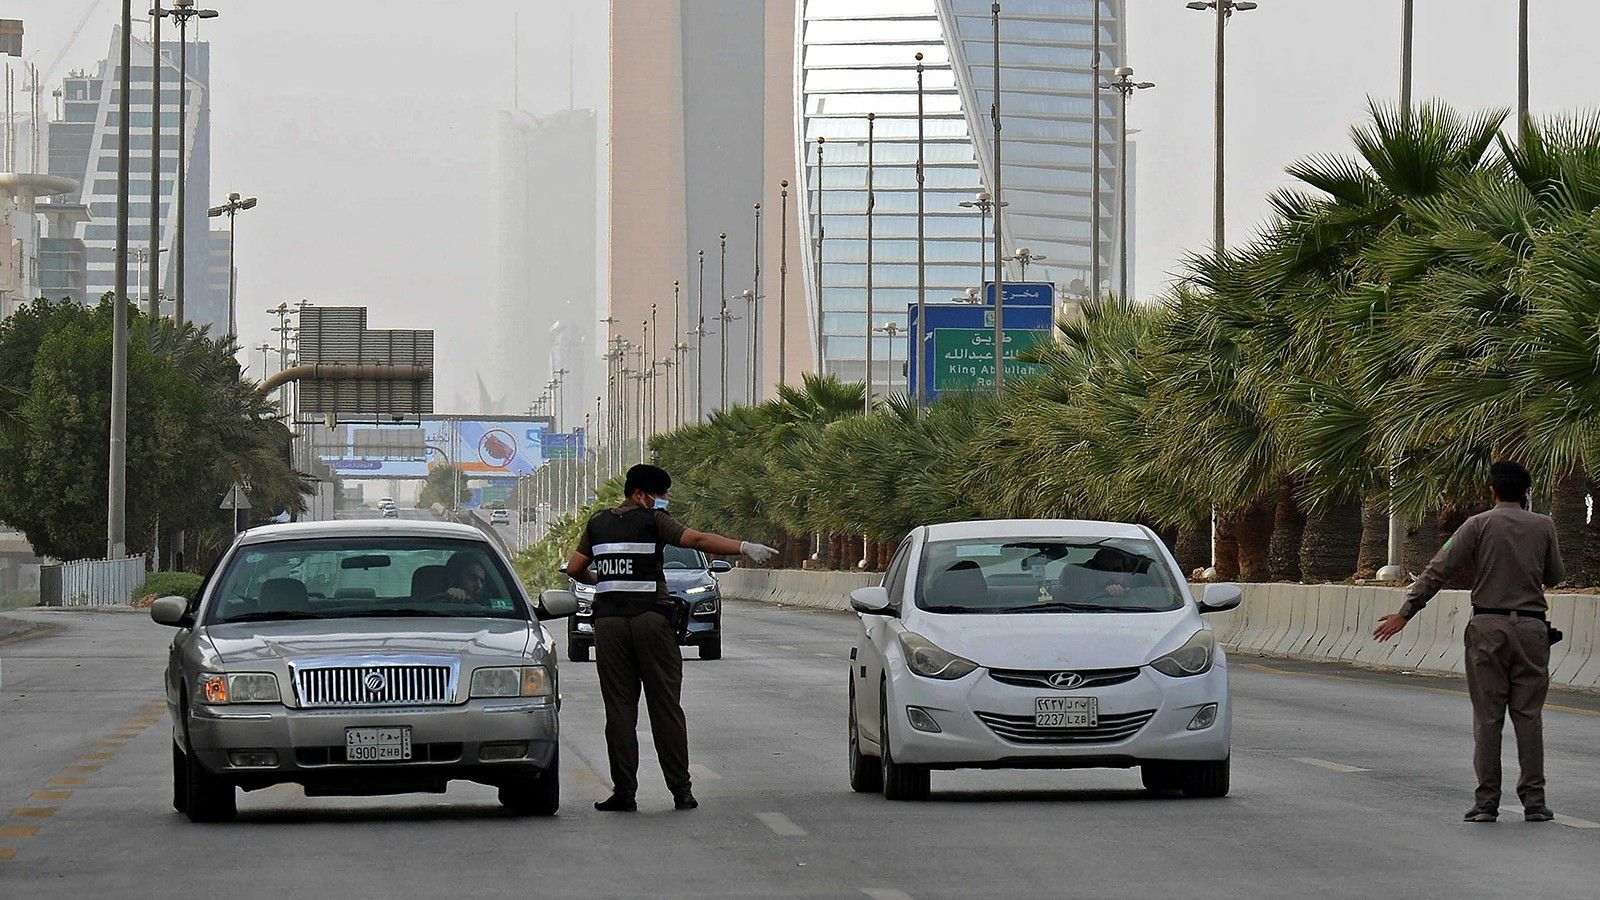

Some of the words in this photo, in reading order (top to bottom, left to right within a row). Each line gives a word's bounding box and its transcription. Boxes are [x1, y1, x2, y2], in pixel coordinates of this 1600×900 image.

[950, 365, 976, 376] King
[981, 365, 1036, 375] Abullah
[597, 558, 633, 575] POLICE
[1037, 713, 1065, 726] 2237
[1067, 715, 1087, 724] LZB
[349, 746, 377, 760] 4900
[380, 748, 400, 757] ZHB
